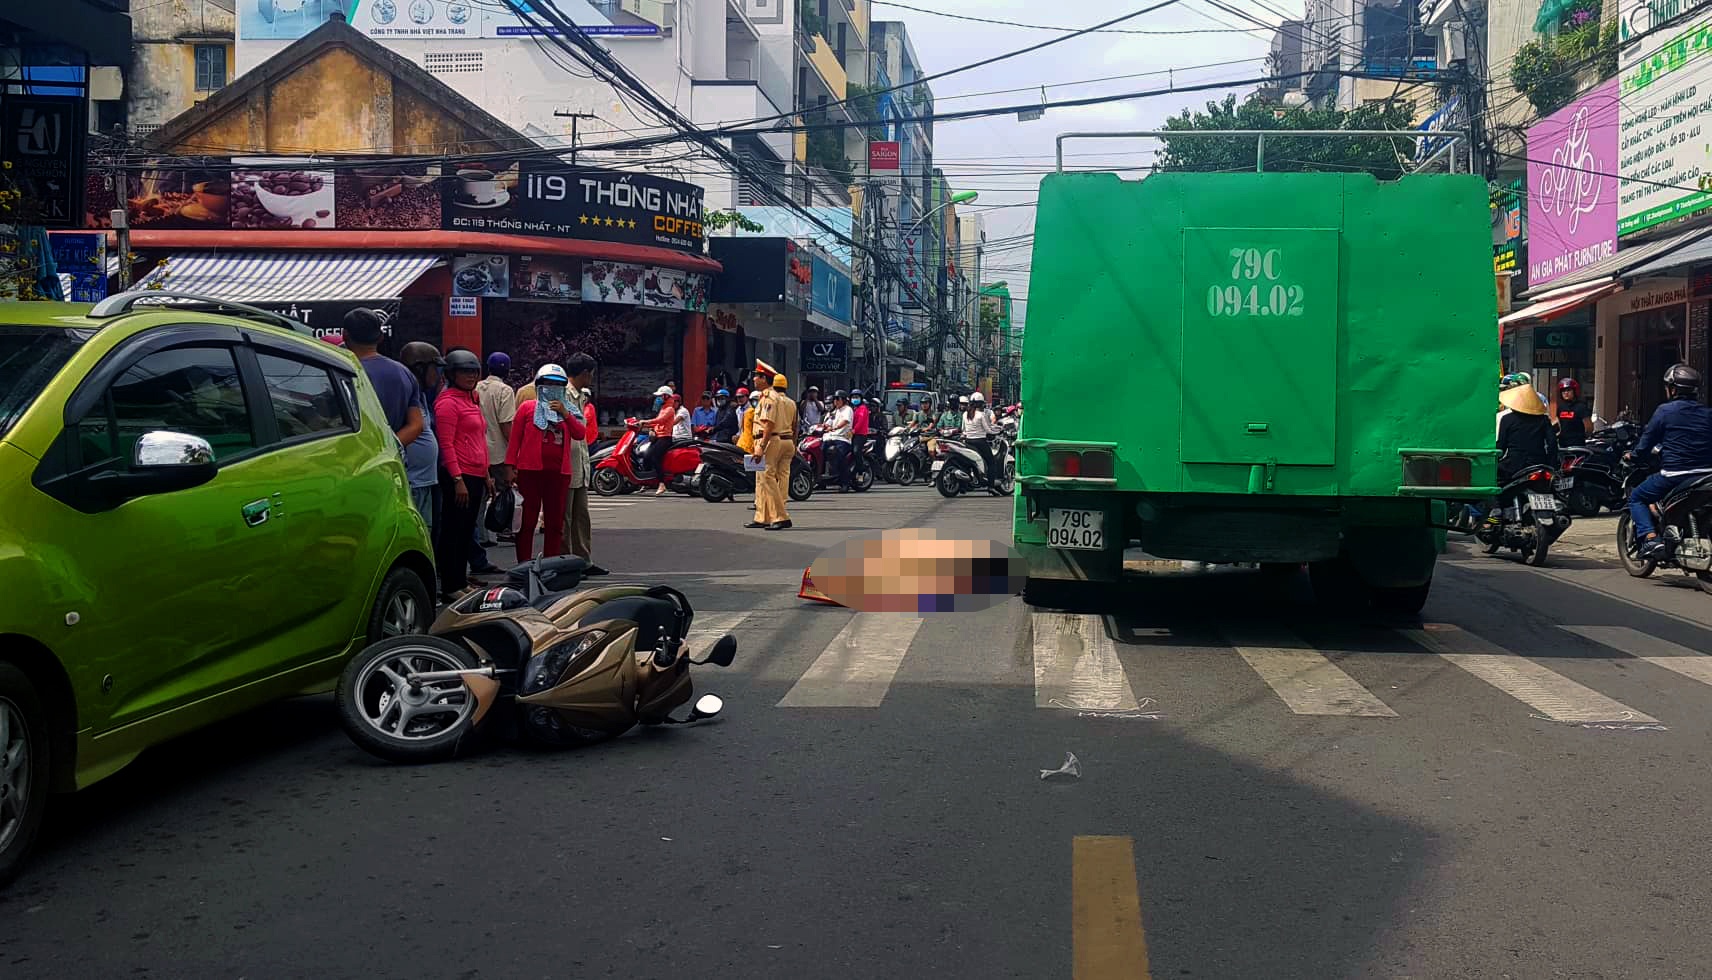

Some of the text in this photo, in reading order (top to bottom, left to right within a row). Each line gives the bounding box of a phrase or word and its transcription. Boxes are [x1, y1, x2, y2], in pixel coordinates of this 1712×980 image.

[1685, 84, 1697, 101] LED
[527, 174, 567, 201] 119
[579, 174, 661, 212] THỐNG
[557, 224, 571, 233] NT
[654, 215, 703, 238] COFFEE
[1229, 247, 1282, 281] 79C
[1531, 263, 1541, 281] AN
[1541, 259, 1553, 277] GIA
[1554, 249, 1573, 274] PHÁT
[1573, 239, 1613, 269] FURNITURE
[1206, 284, 1305, 317] 094.02
[1062, 510, 1091, 528] 79C
[1050, 528, 1102, 548] 094.02
